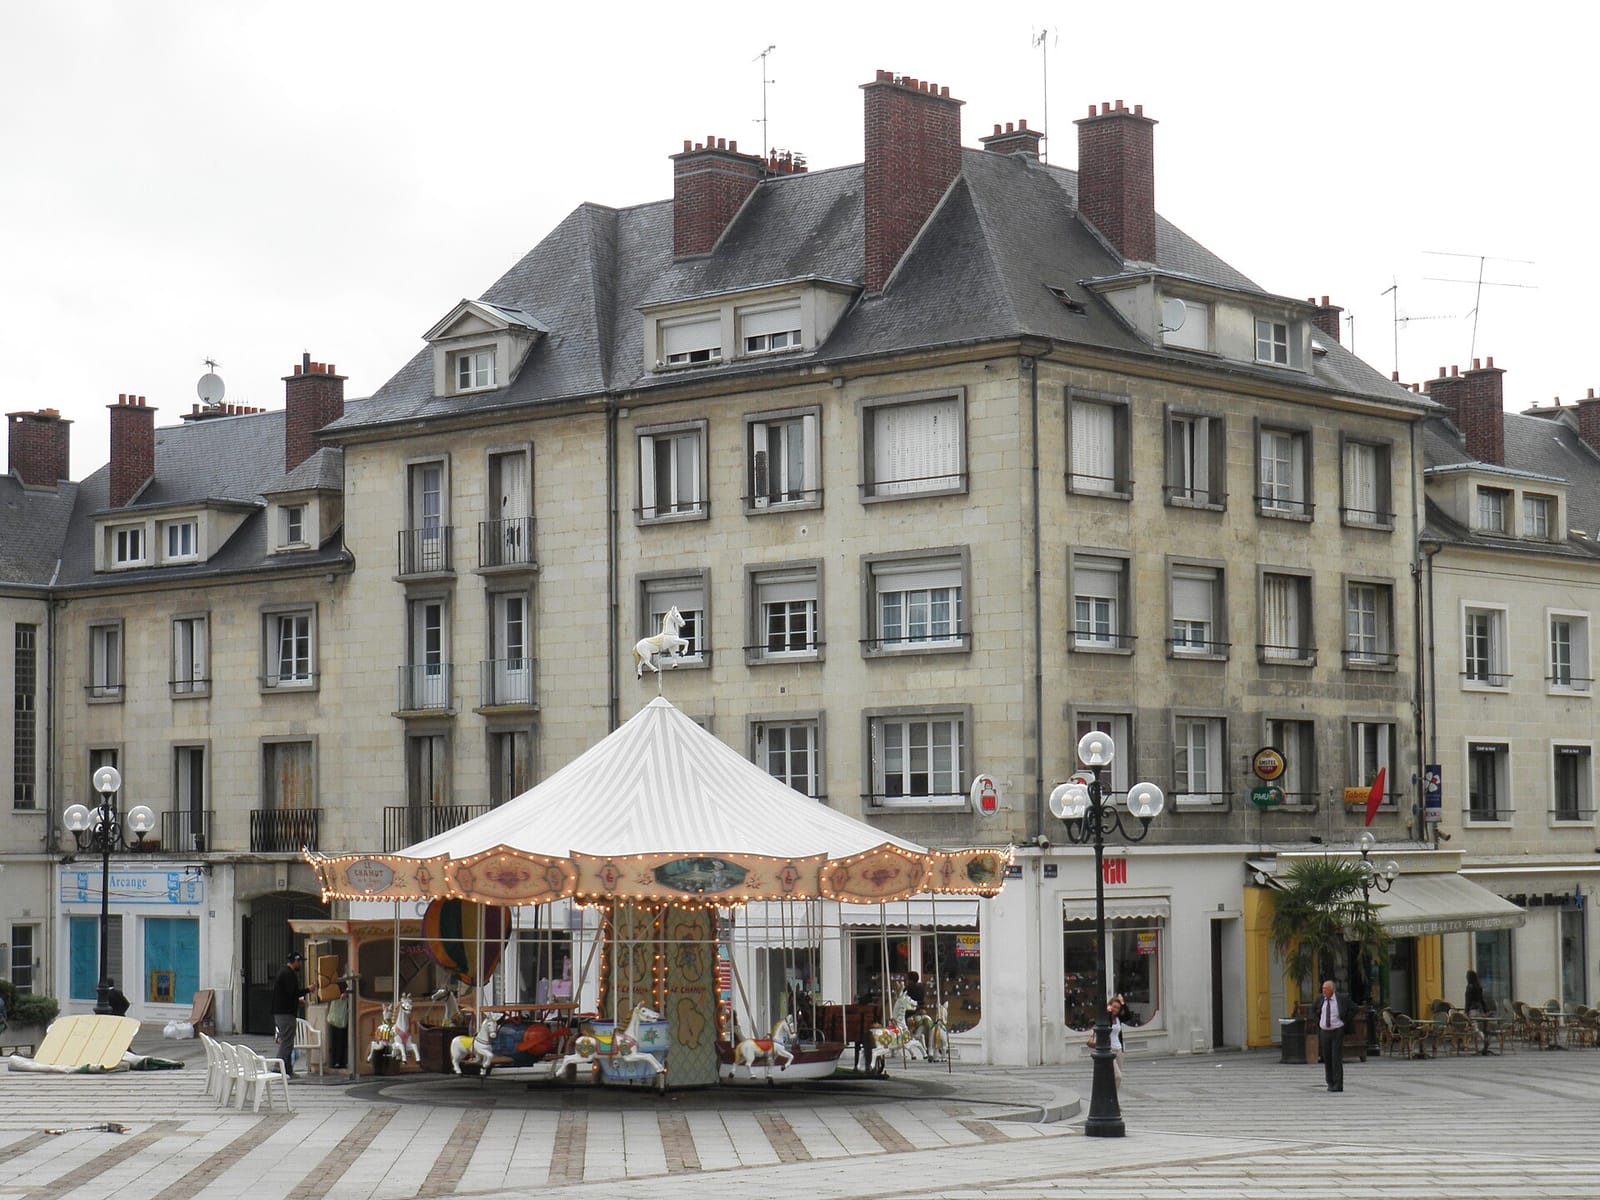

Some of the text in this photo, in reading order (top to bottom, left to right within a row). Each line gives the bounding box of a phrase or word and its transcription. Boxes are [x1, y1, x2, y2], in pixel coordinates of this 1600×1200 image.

[1253, 792, 1270, 800] PMU
[1344, 790, 1369, 799] Tabac
[109, 876, 148, 890] Arcange
[1391, 924, 1415, 935] TABAC
[1418, 922, 1430, 934] LE
[1465, 919, 1482, 928] PMU
